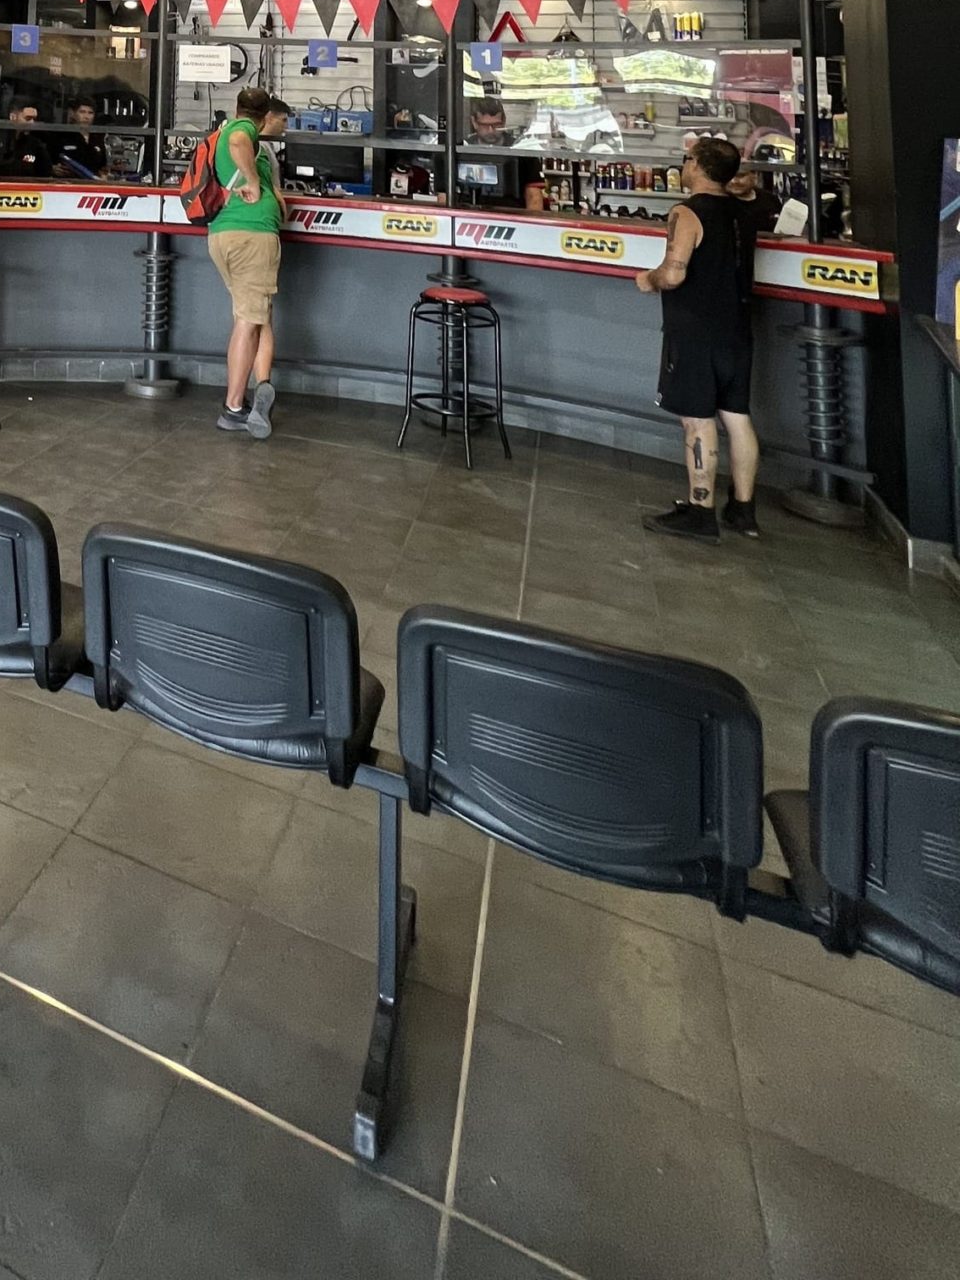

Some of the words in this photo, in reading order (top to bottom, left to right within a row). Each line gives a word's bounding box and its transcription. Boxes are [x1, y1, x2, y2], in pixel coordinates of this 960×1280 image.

[20, 31, 32, 47] 3
[316, 46, 329, 61] 2
[480, 49, 491, 65] 1
[386, 218, 433, 233] RAN
[565, 236, 619, 253] RAN
[807, 264, 872, 286] RAN
